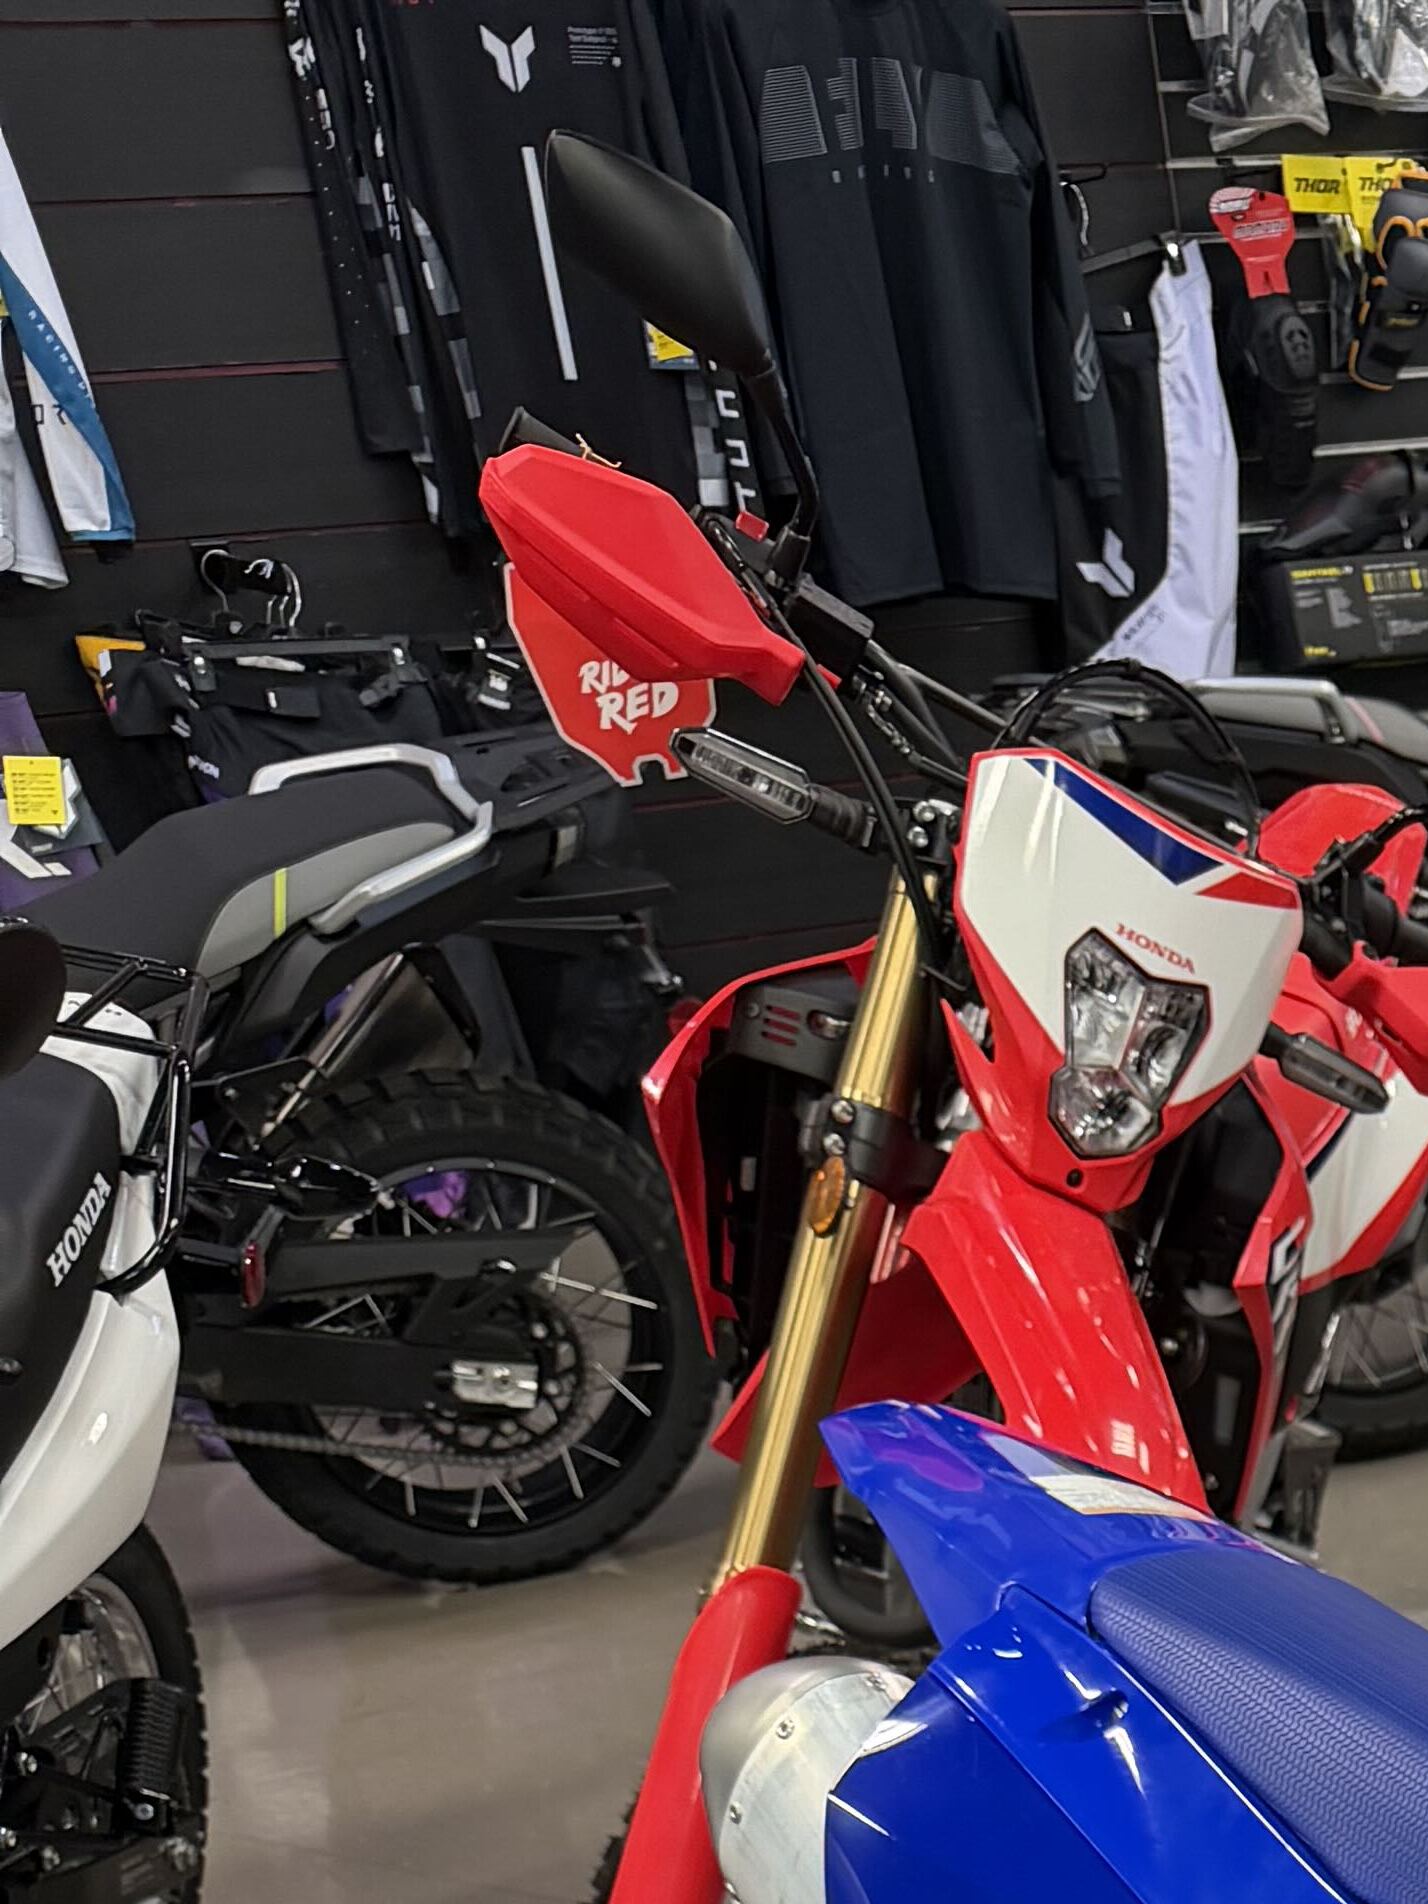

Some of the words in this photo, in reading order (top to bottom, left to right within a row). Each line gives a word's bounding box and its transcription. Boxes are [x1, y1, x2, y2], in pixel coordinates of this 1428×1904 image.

[1294, 177, 1341, 194] THOR
[1359, 176, 1394, 192] THO
[579, 659, 630, 695] RID
[596, 682, 679, 736] RED
[1114, 922, 1195, 975] HONDA
[46, 1171, 111, 1288] HONDA
